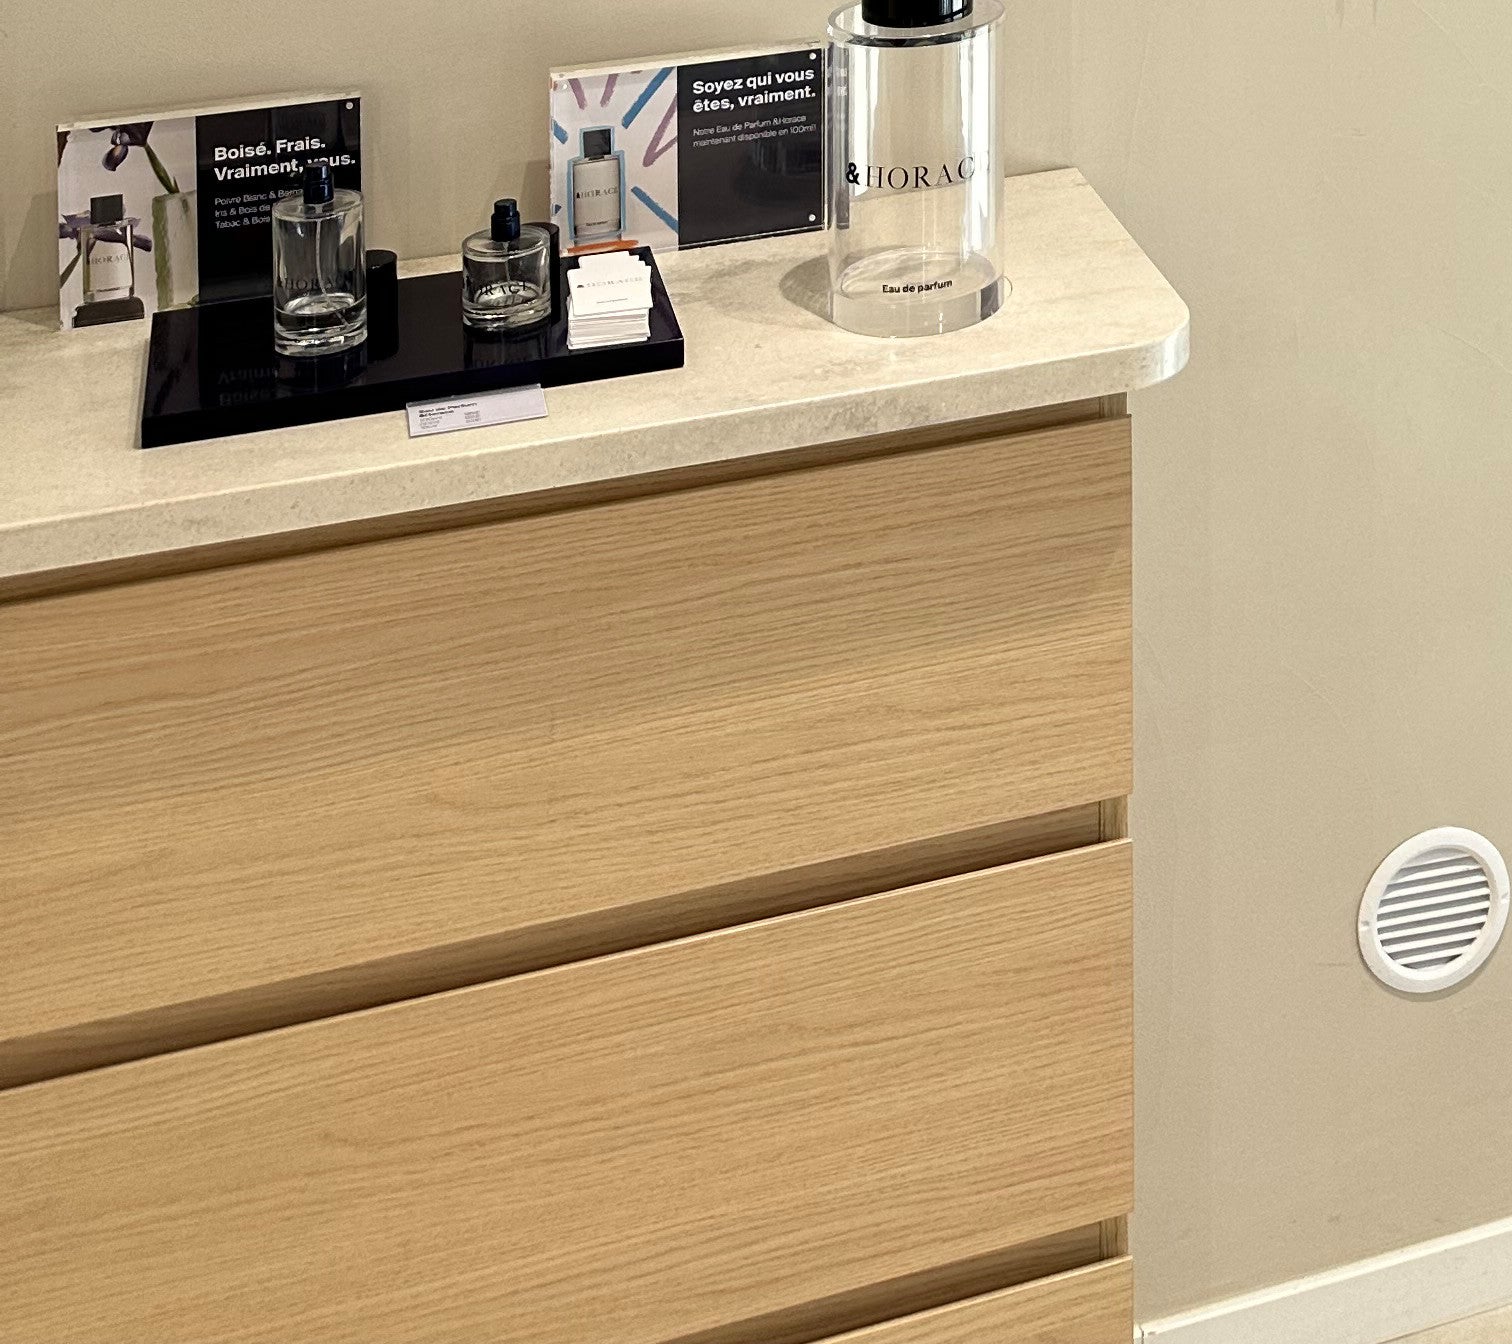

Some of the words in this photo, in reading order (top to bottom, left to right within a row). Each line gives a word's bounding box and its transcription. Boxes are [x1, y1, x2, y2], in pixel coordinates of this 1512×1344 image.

[692, 78, 743, 95] Soyez
[746, 72, 772, 89] qui
[775, 69, 815, 84] vous
[692, 98, 735, 113] êtes,
[738, 85, 816, 107] vraiment.
[732, 123, 743, 131] de
[744, 120, 772, 130] Parfum
[692, 134, 737, 147] maintenant
[737, 130, 778, 142] disponible
[778, 128, 789, 136] en
[214, 141, 272, 162] Boisé.
[276, 136, 326, 154] Frais.
[214, 158, 304, 181] Vraiment,
[846, 156, 976, 190] &HORAC
[214, 196, 241, 206] Poivre
[269, 190, 276, 199] &
[229, 207, 237, 216] &
[259, 203, 271, 212] de
[214, 219, 241, 229] Tabac
[243, 218, 251, 226] &
[882, 284, 900, 294] Eau
[902, 283, 915, 293] de
[917, 279, 953, 294] parfum
